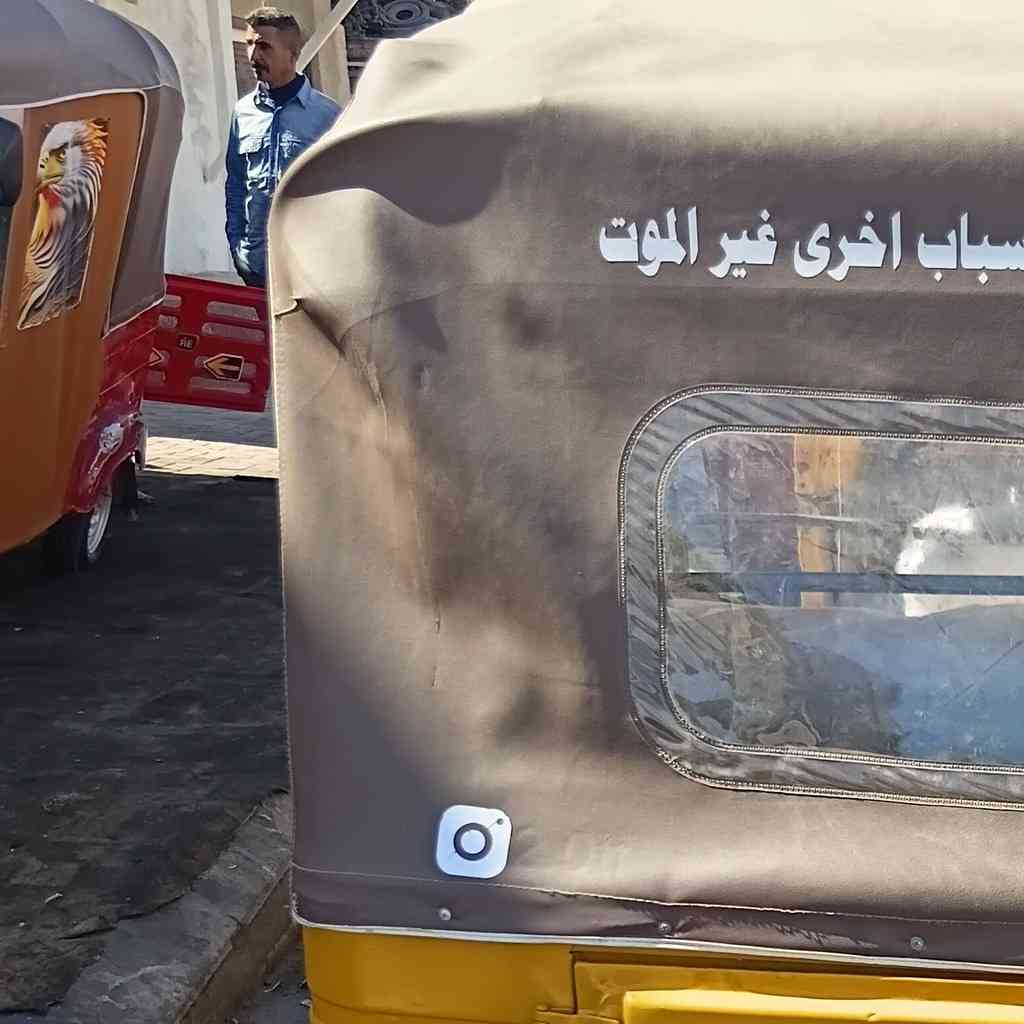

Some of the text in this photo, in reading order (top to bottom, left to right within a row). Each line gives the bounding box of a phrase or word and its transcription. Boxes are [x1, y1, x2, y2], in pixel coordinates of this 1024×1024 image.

[600, 205, 699, 277] الموت
[708, 208, 778, 279] غير
[793, 209, 902, 282] اخرى
